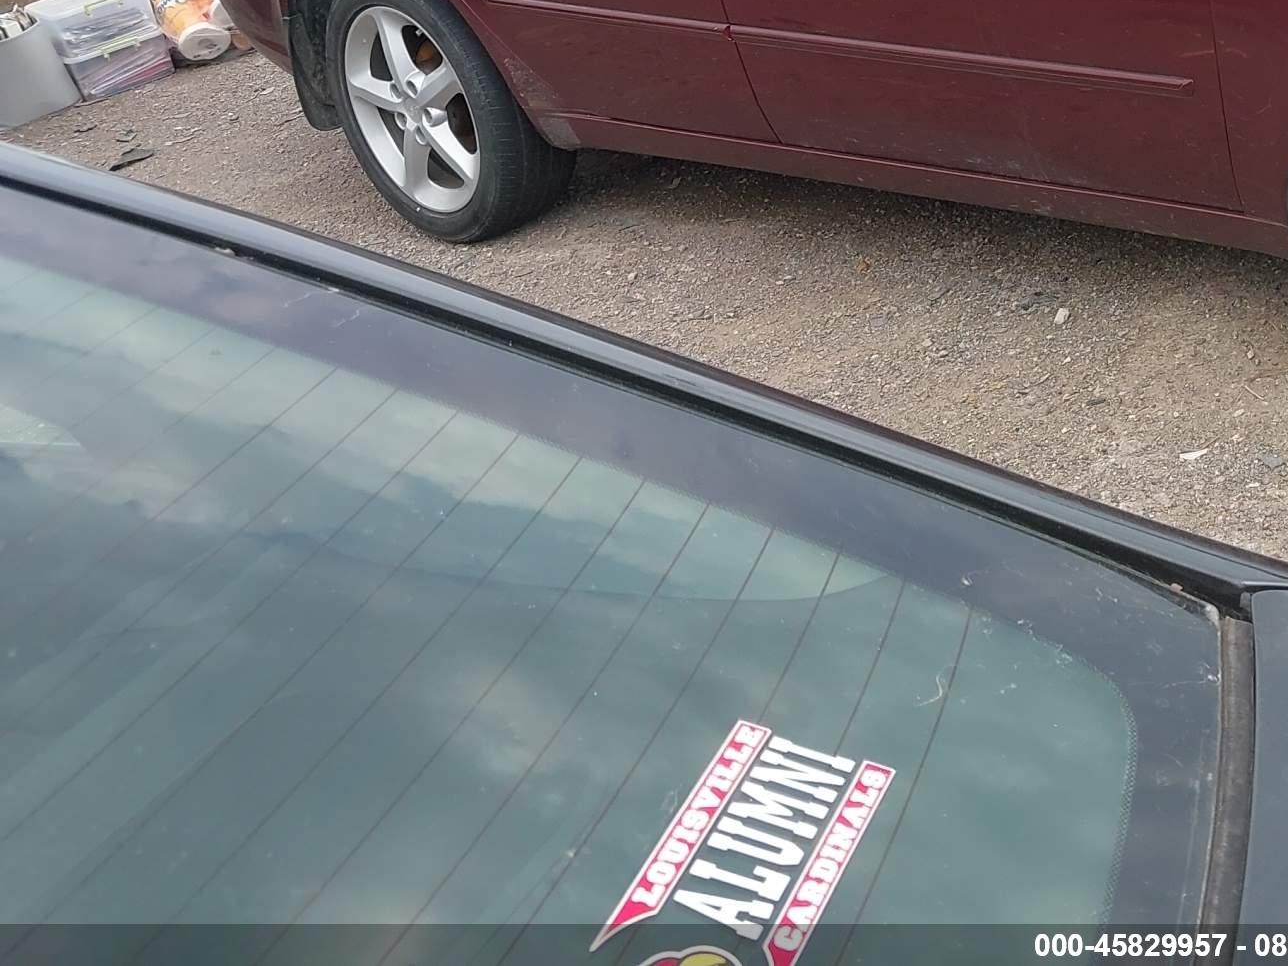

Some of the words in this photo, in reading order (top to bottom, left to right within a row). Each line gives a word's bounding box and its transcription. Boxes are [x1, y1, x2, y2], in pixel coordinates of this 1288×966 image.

[632, 724, 765, 908] LOUISVILLE
[673, 735, 856, 941] ALUMNI
[774, 768, 887, 952] CARDINALS
